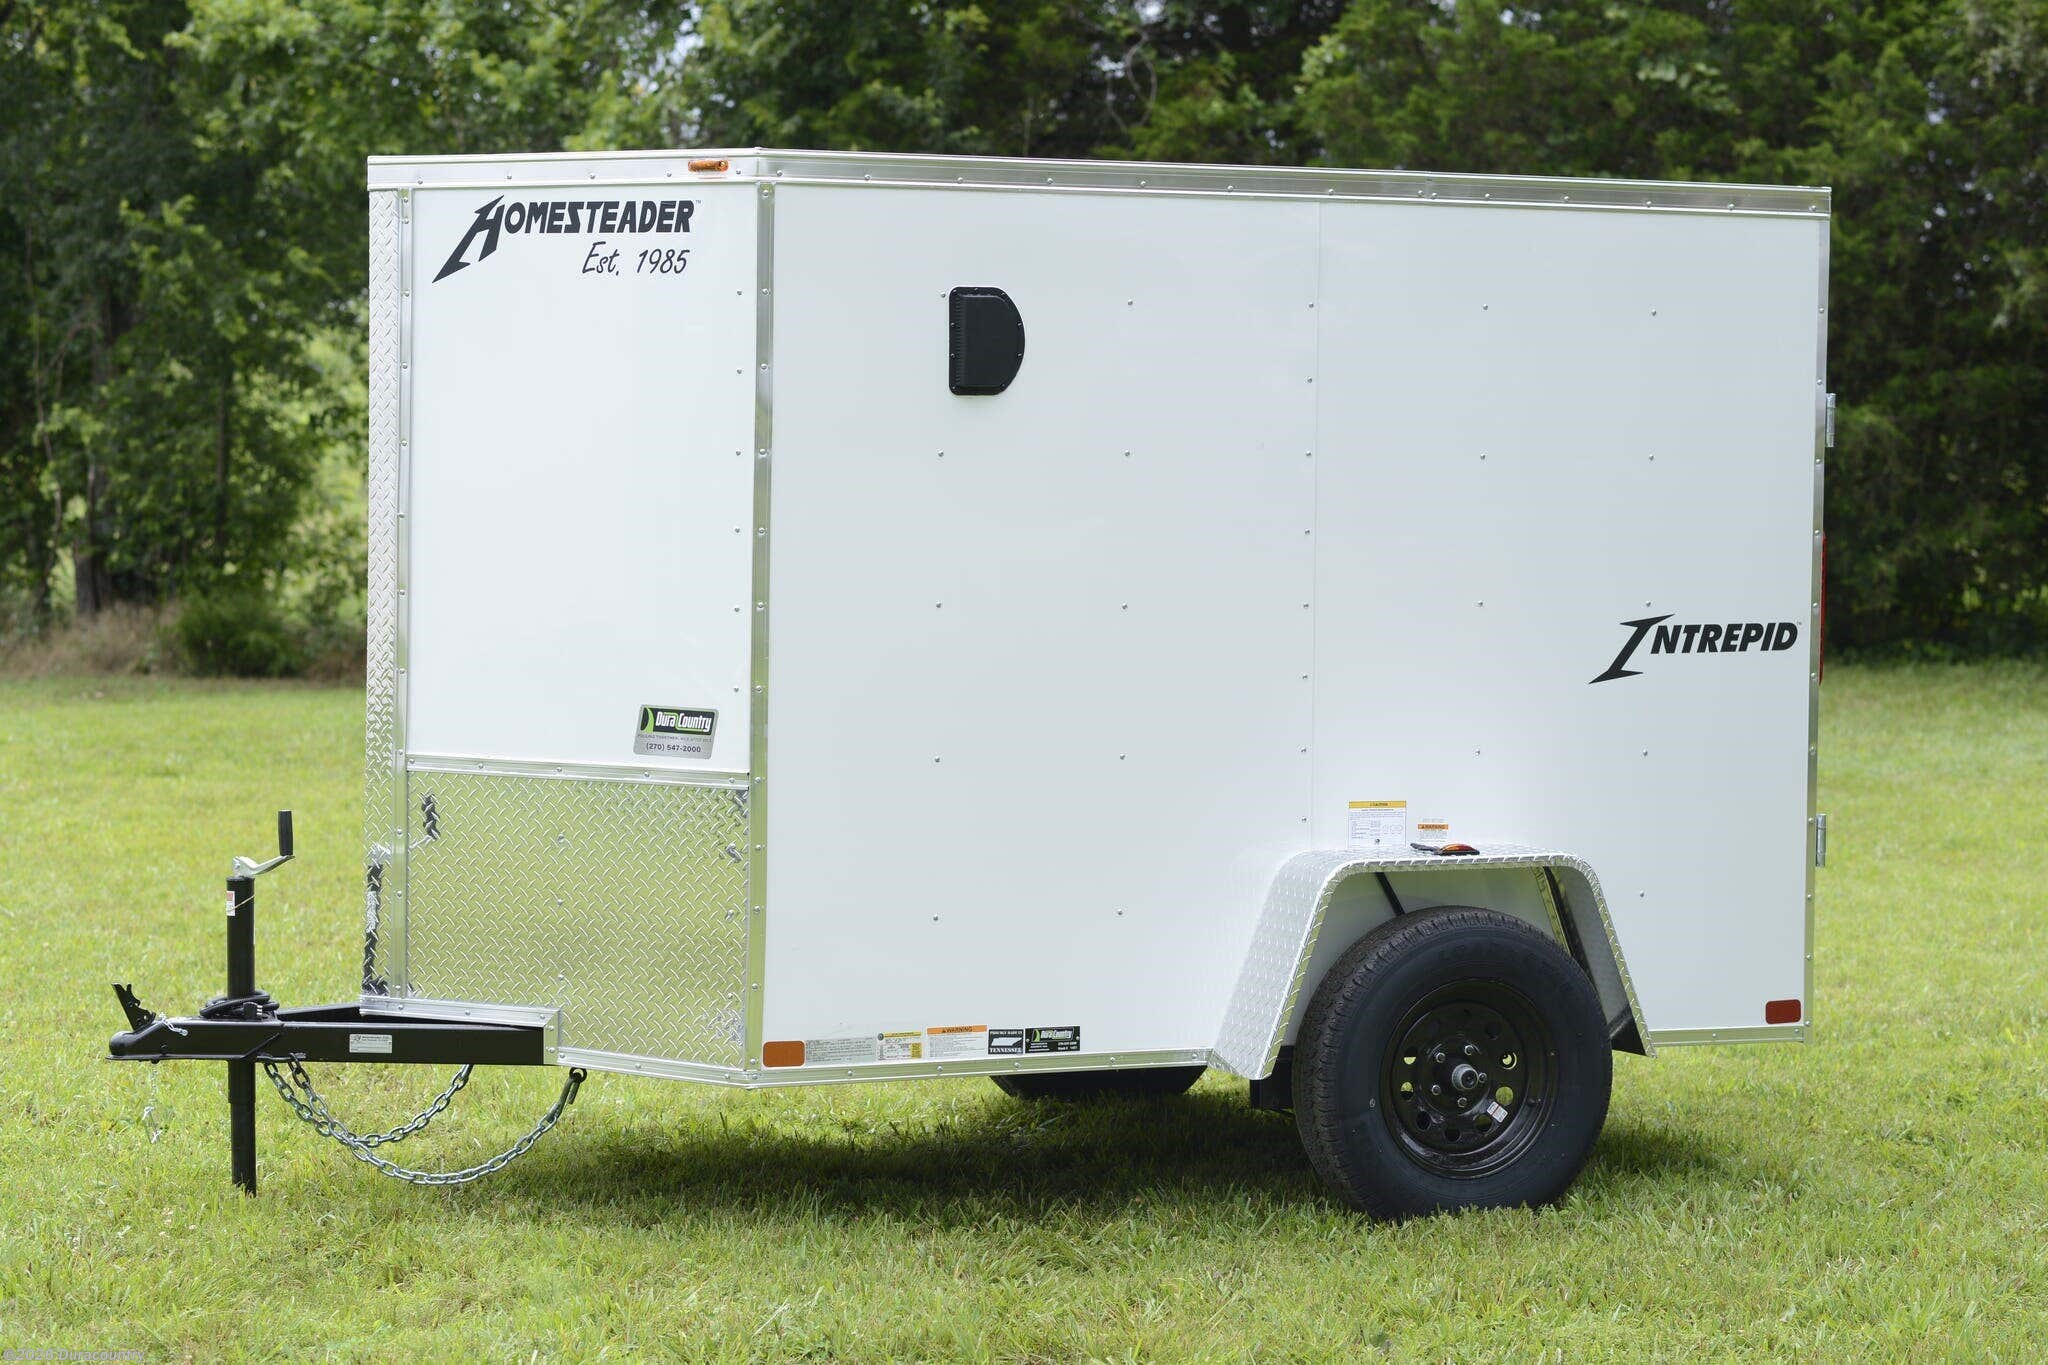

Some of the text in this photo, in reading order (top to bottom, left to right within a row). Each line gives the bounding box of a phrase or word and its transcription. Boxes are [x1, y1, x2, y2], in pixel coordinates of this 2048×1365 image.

[431, 194, 694, 283] HOMESTEADER
[582, 241, 690, 275] Est. 1985
[1588, 613, 1799, 686] INTREPID
[656, 711, 712, 733] Dura Country
[646, 742, 701, 753] (270) 547-2000
